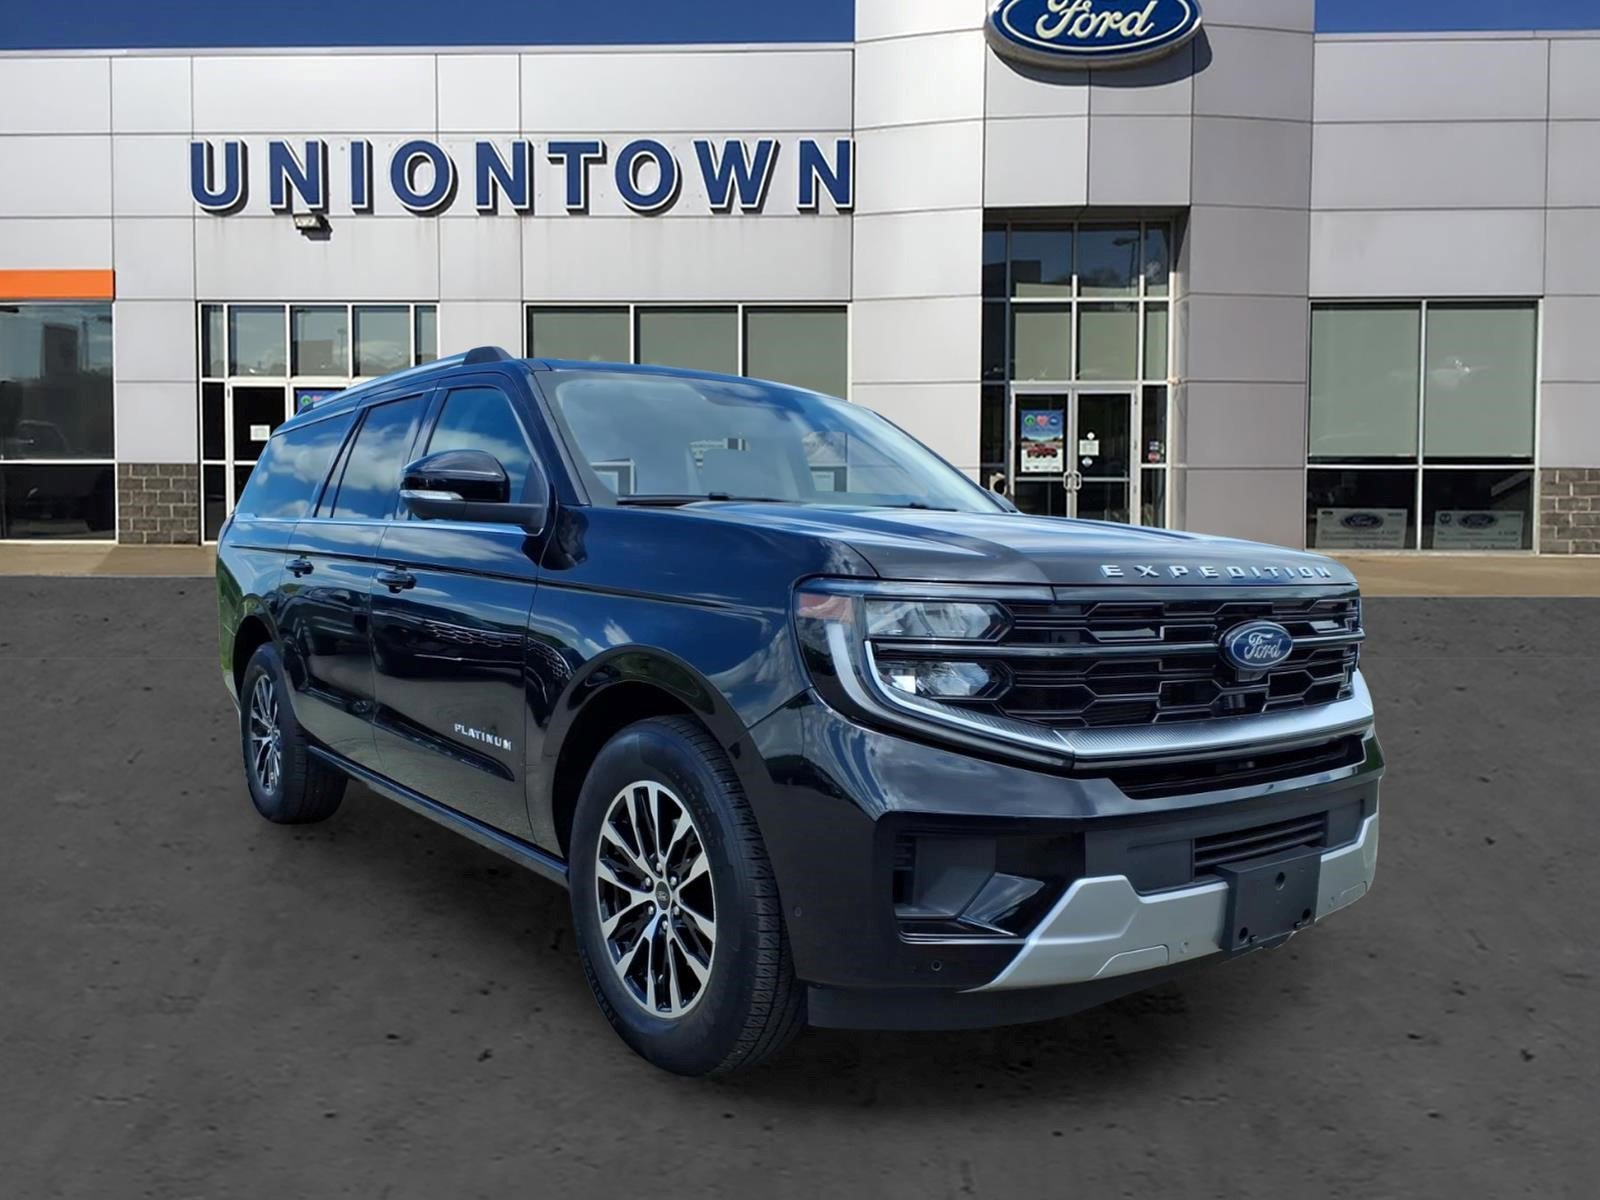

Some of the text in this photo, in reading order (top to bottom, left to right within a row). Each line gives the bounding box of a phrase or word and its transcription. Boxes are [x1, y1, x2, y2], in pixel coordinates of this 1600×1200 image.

[1035, 0, 1155, 39] Ford
[190, 138, 854, 213] UNIONTOWN
[1100, 564, 1332, 578] EXPEDITION
[1243, 631, 1283, 660] Ford
[453, 722, 513, 752] PLATINUM
